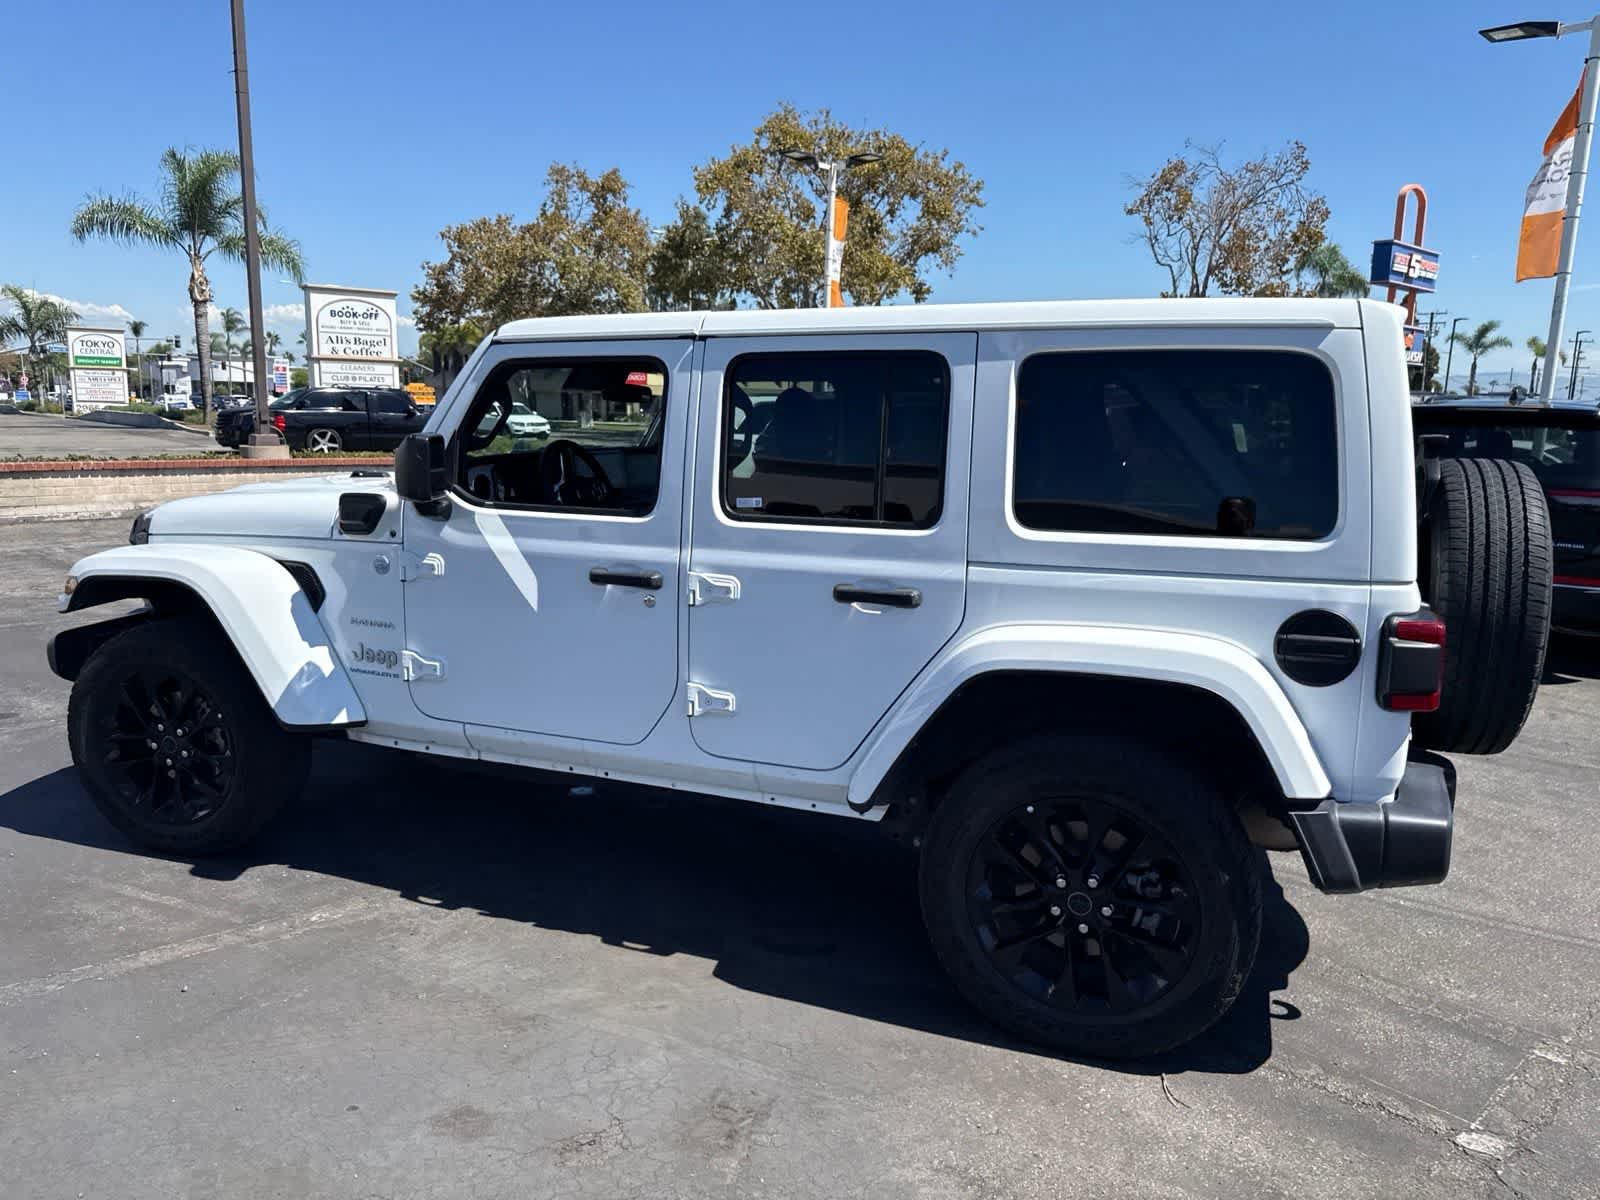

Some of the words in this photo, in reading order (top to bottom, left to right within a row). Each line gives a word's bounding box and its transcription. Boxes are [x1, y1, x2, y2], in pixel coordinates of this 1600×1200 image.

[330, 309, 379, 320] BOOK-OFF
[80, 340, 115, 349] TOKYO
[325, 335, 351, 345] Ali's
[354, 336, 387, 348] Bagel
[331, 346, 338, 355] &
[343, 347, 382, 357] Coffee
[340, 364, 375, 372] CLEANERS
[331, 374, 350, 382] CLUB
[358, 375, 385, 383] PILATES
[351, 641, 398, 669] Jeep
